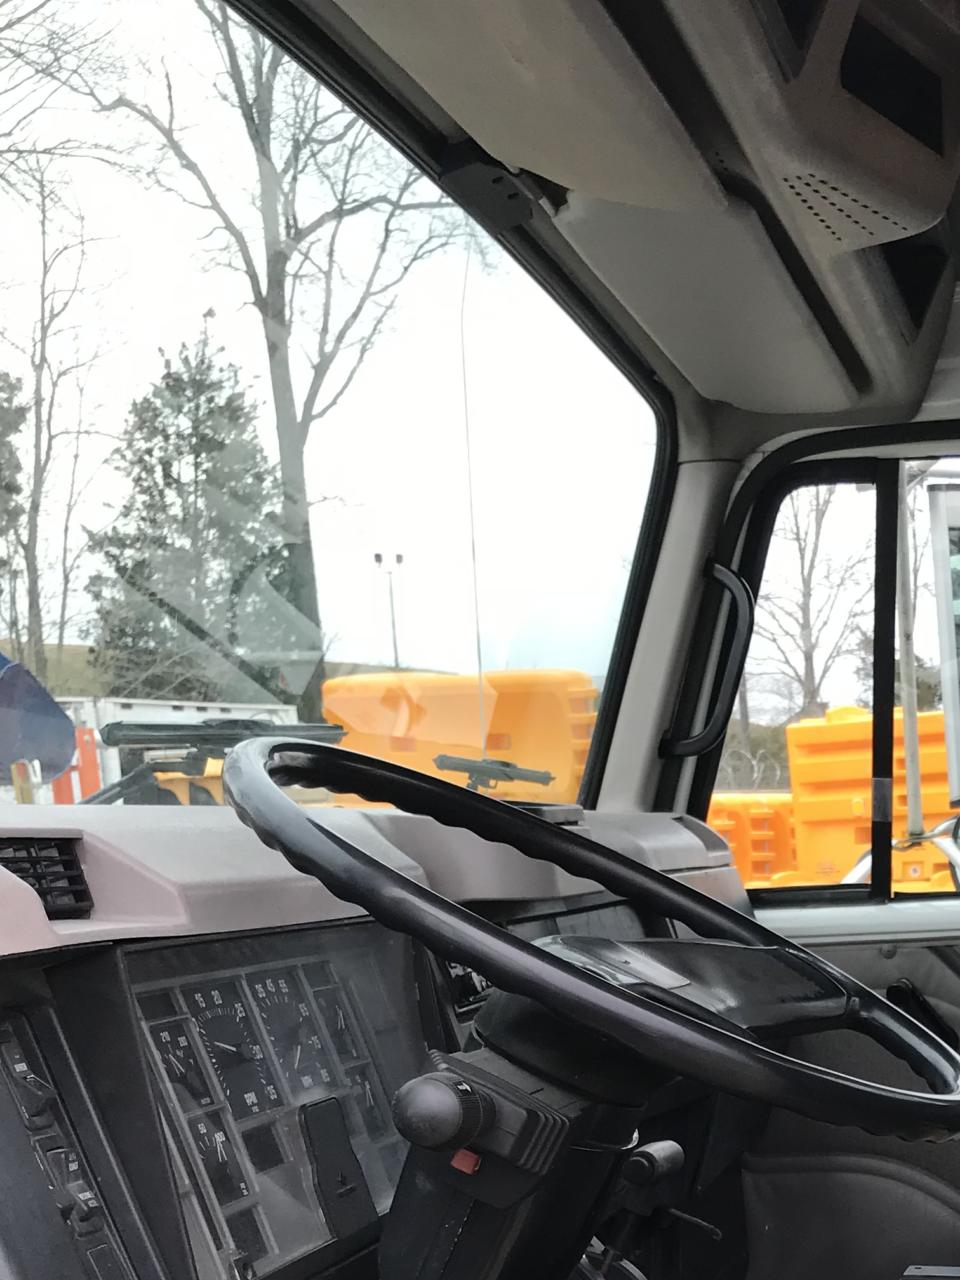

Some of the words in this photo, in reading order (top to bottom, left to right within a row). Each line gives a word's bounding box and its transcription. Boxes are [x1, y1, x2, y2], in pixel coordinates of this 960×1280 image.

[195, 993, 205, 1008] 15
[211, 990, 222, 1005] 20
[234, 1002, 246, 1017] 25
